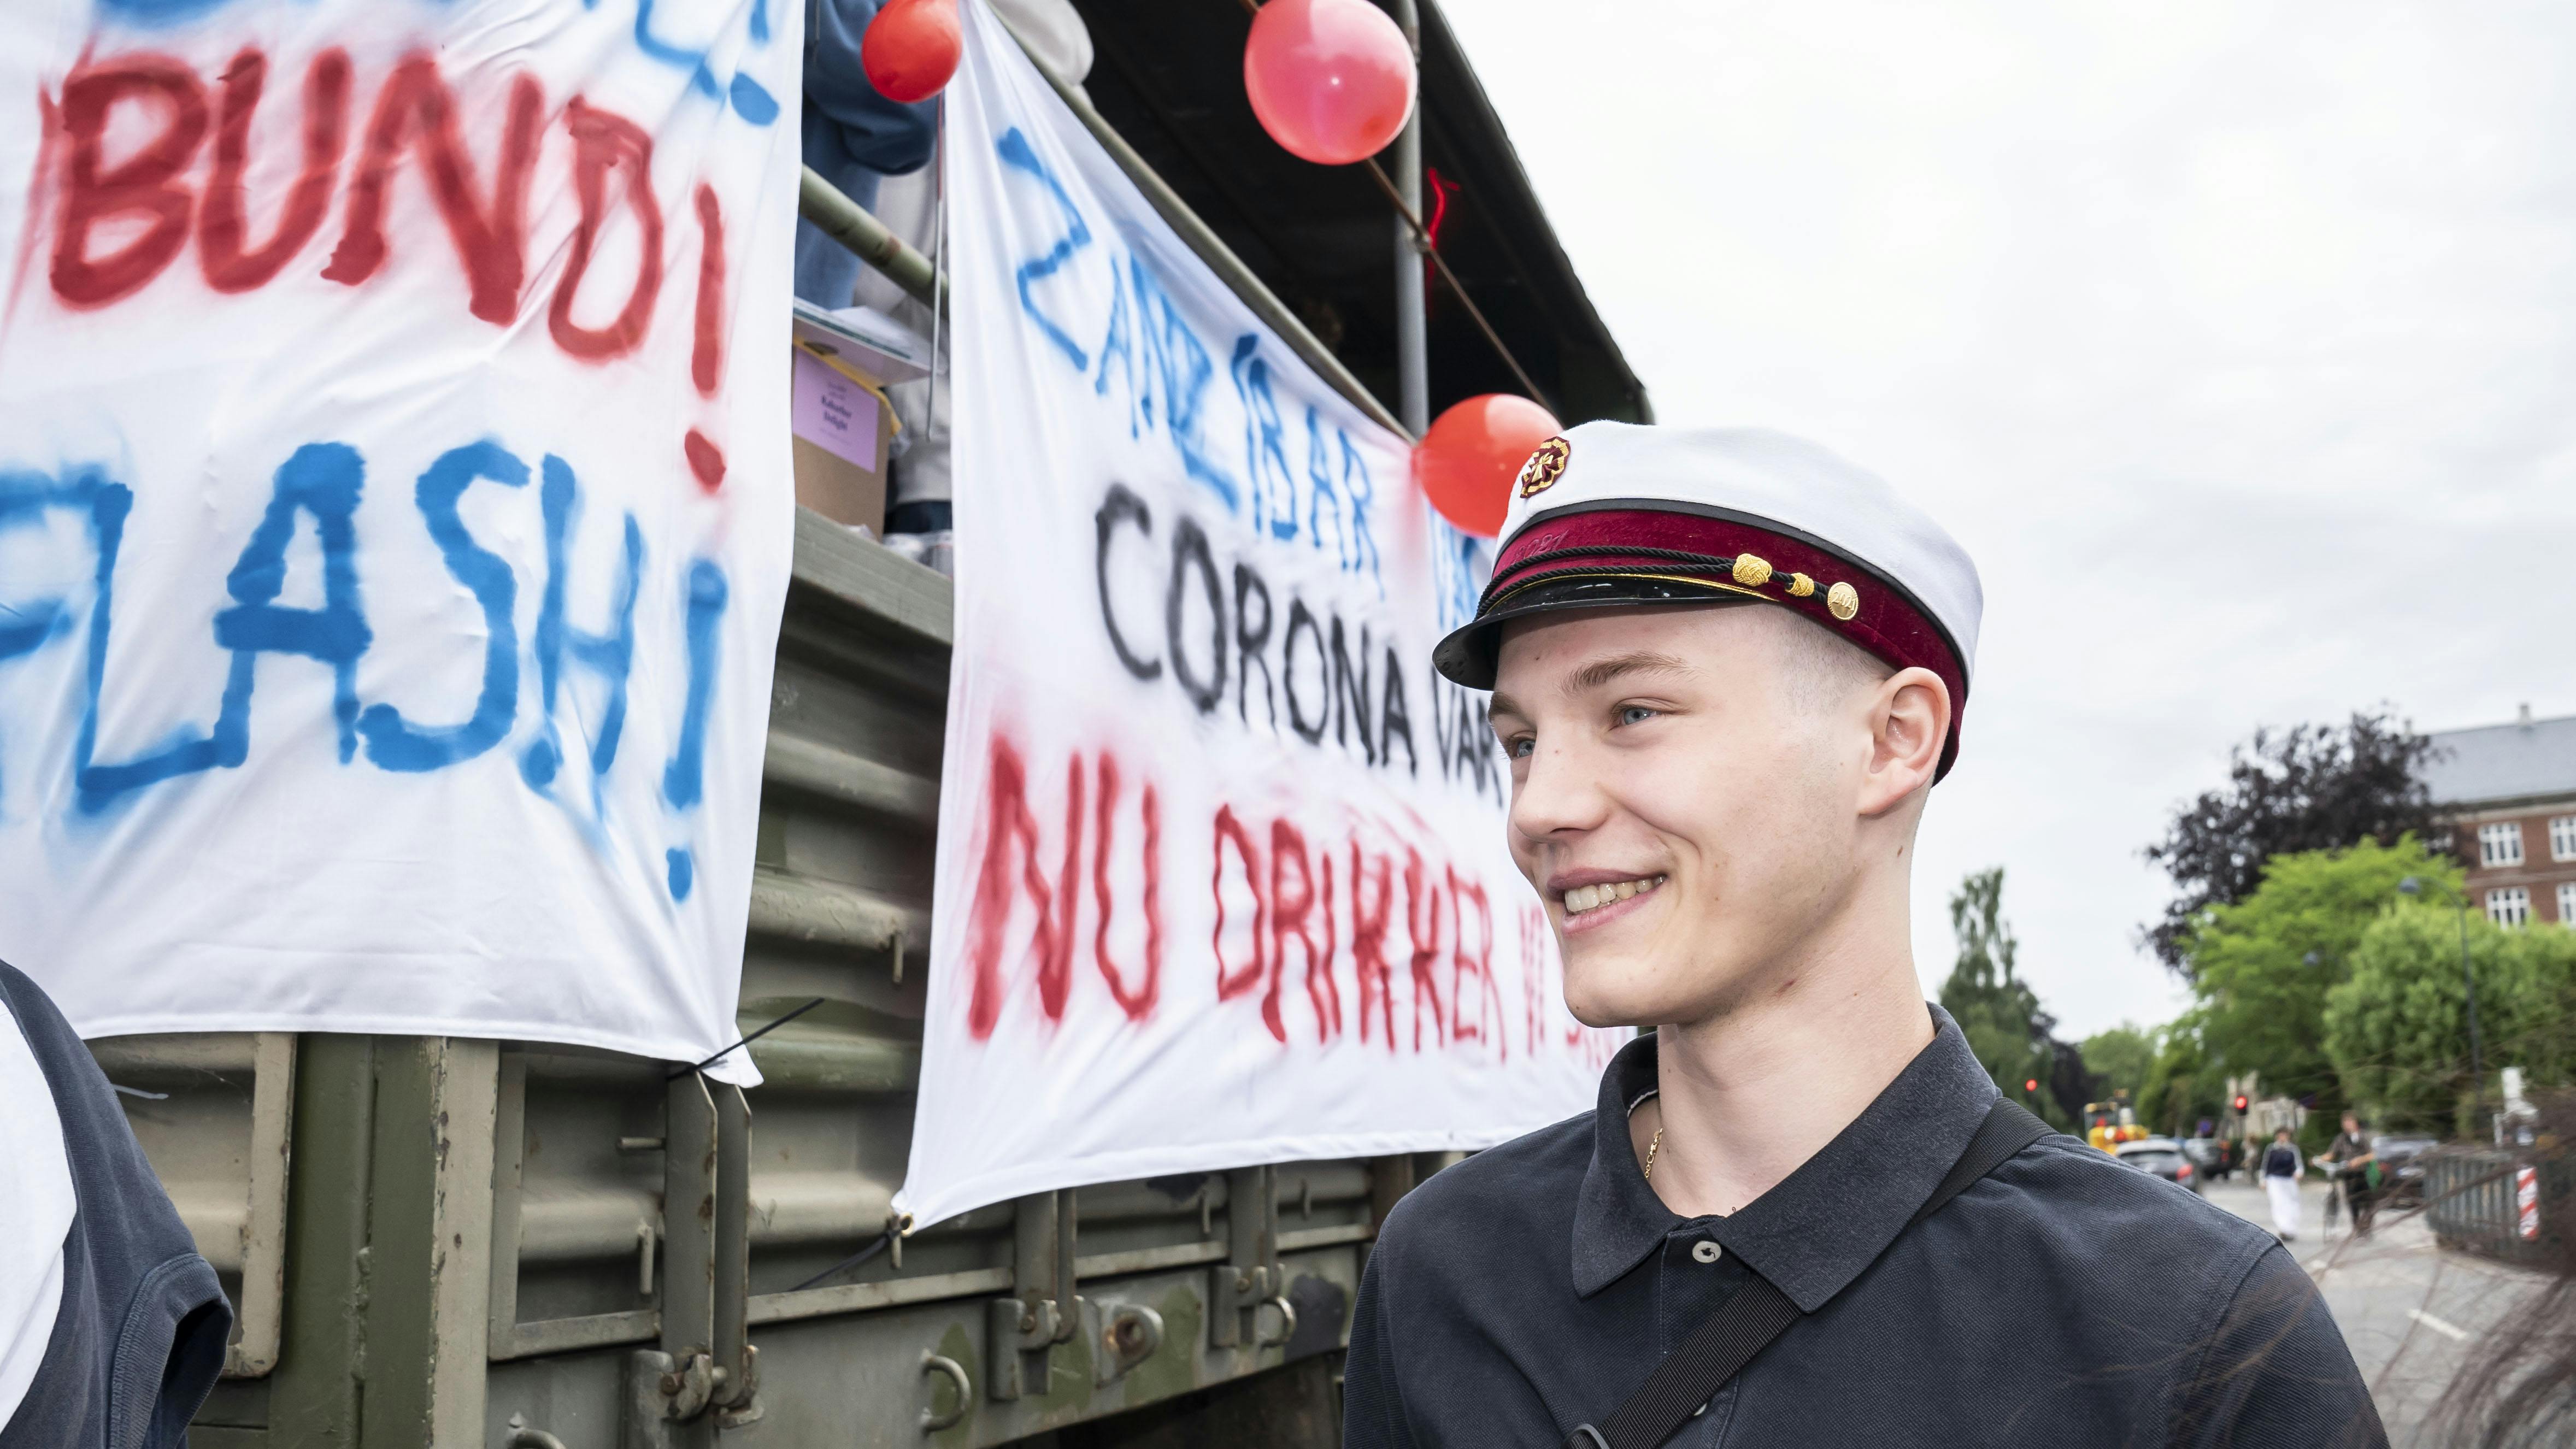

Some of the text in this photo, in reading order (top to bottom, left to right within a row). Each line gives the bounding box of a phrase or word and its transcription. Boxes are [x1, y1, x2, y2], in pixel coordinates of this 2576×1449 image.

[997, 126, 1385, 601] ZANZIBAR
[1095, 481, 1418, 779] CORONA
[1431, 663, 1504, 810] VAR
[1831, 591, 1857, 611] 2021
[967, 732, 1163, 1041] NU
[1213, 801, 1507, 1064] DRIKKER
